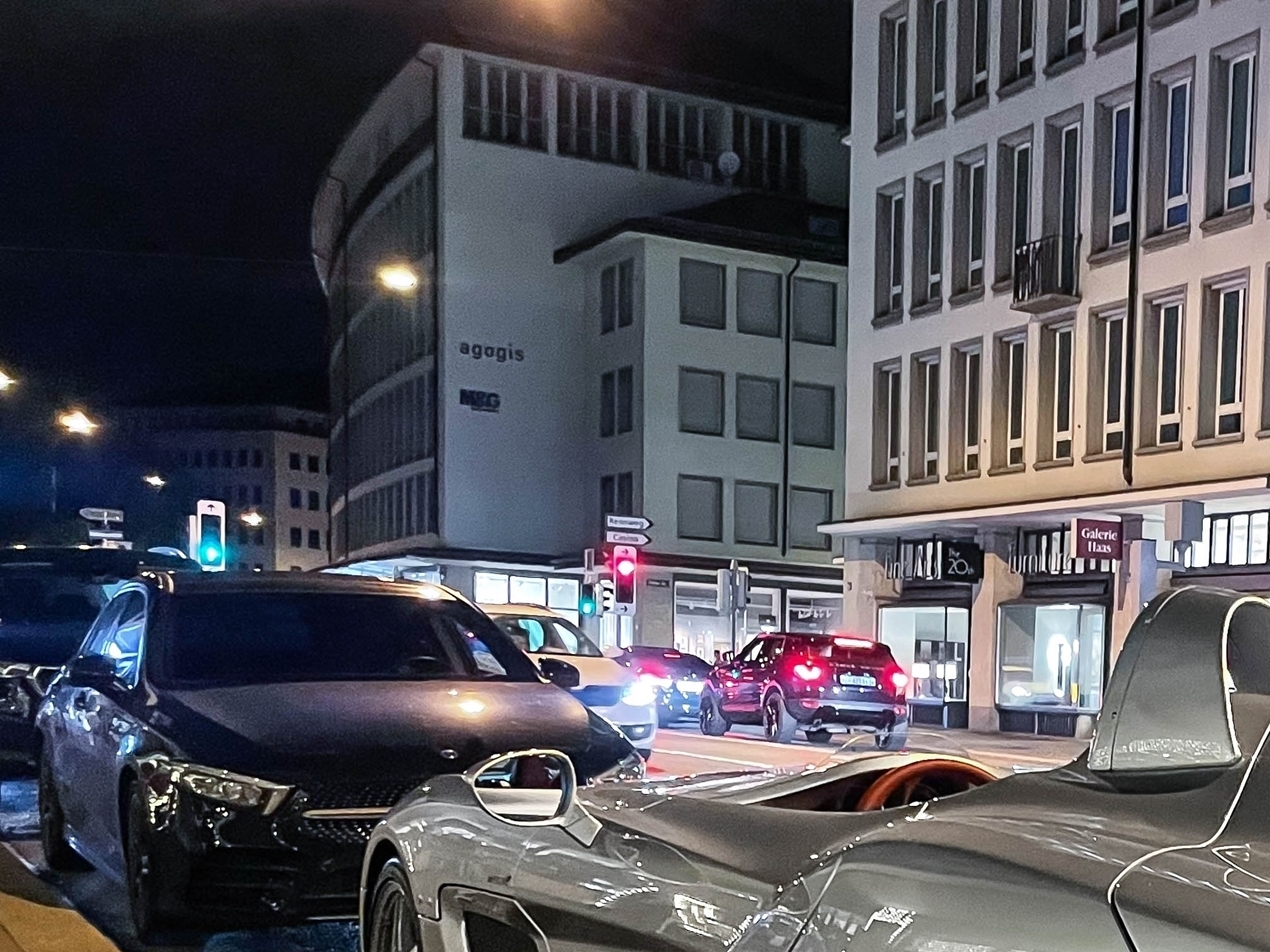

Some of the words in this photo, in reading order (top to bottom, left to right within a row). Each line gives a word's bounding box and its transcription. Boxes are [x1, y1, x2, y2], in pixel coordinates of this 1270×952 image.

[459, 343, 525, 363] agogis
[1081, 526, 1118, 541] Galerie
[1088, 541, 1112, 553] Haas
